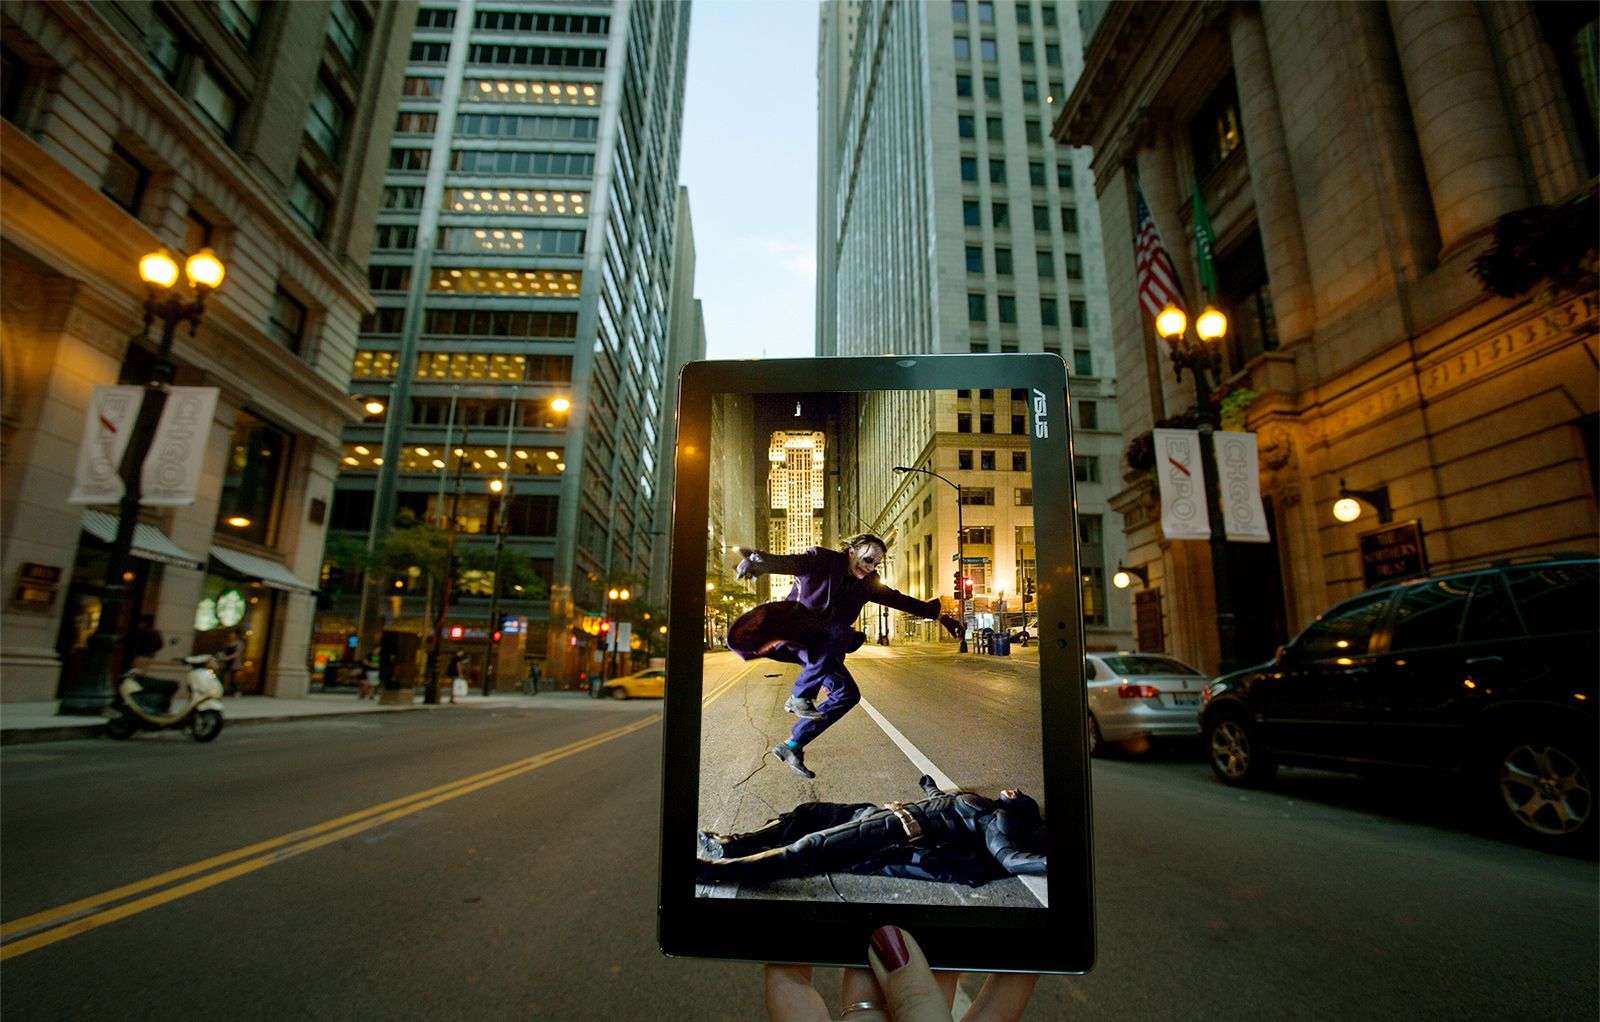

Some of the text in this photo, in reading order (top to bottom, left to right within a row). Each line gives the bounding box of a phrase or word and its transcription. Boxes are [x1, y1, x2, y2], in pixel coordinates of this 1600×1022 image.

[1033, 388, 1049, 439] ASUS
[1166, 437, 1197, 521] EXPO
[1223, 440, 1254, 524] CHGO
